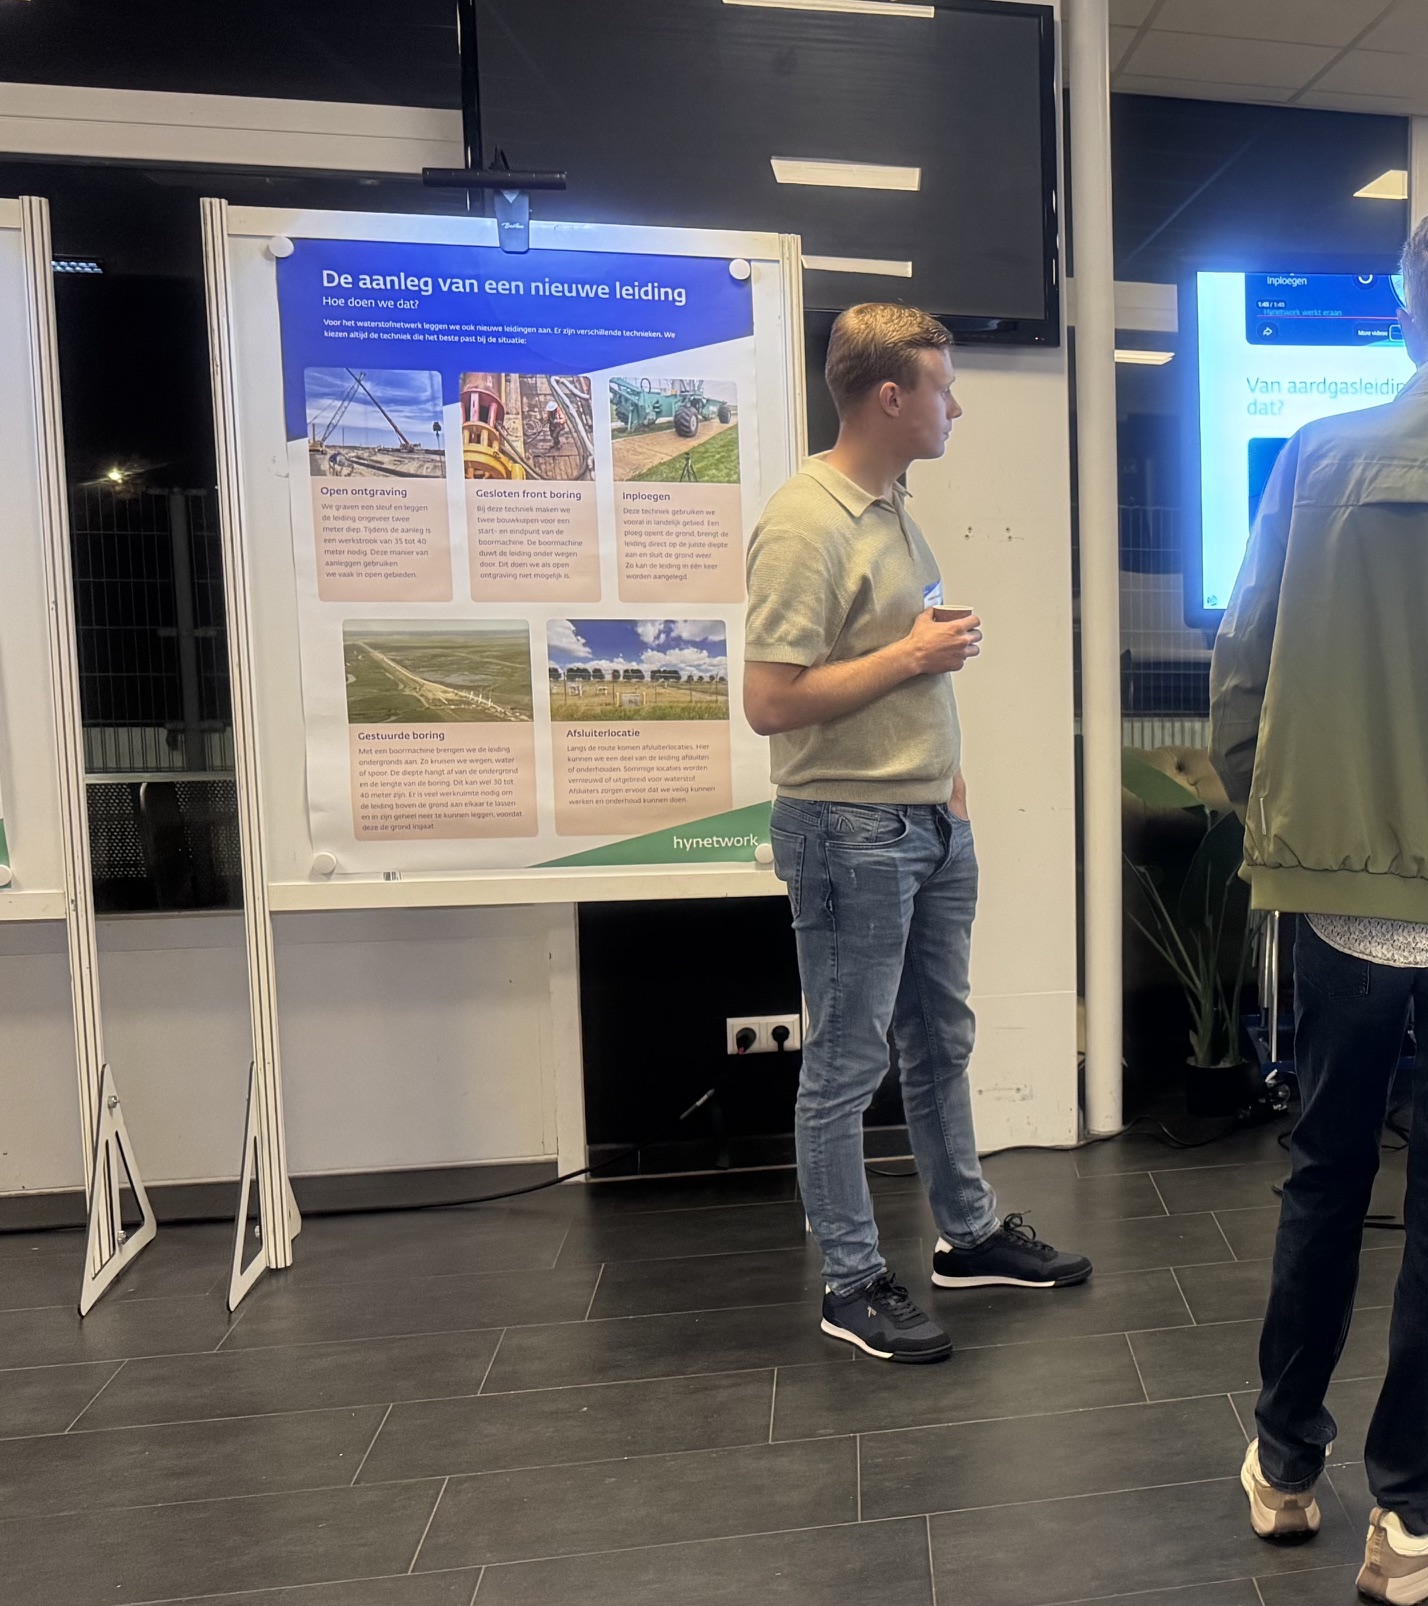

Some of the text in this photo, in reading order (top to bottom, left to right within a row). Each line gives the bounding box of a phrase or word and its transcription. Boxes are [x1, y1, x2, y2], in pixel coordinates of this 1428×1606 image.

[323, 268, 686, 306] De aanleg van een nieuwe leiding
[1266, 276, 1307, 287] Inploegen
[323, 295, 419, 309] Hoe doen we dat?
[324, 318, 341, 326] Voor
[357, 319, 422, 329] waterstofnetwerk
[424, 322, 448, 331] leggen
[462, 323, 475, 331] ook
[477, 324, 502, 332] nieuwe
[504, 325, 536, 335] leidingen
[554, 326, 561, 334] Er
[563, 327, 575, 336] zijn
[577, 327, 622, 336] verschillende
[623, 329, 662, 338] technieken.
[324, 329, 348, 338] kiezen
[350, 330, 368, 340] altijd
[370, 331, 378, 339] de
[380, 332, 411, 340] techniek
[425, 333, 437, 341] het
[460, 334, 475, 344] past
[477, 335, 486, 344] bij
[488, 335, 496, 343] de
[498, 336, 527, 344] situatie:
[1246, 377, 1406, 400] Van aardgasleidin
[1246, 400, 1284, 416] dat?
[320, 487, 408, 498] Open ontgraving
[476, 488, 582, 501] Gesloten front boring
[623, 491, 670, 503] Inploegen
[358, 731, 445, 741] Gestuurde boring
[567, 729, 640, 737] Afsluiterlocatie
[674, 833, 758, 851] hynetwork
